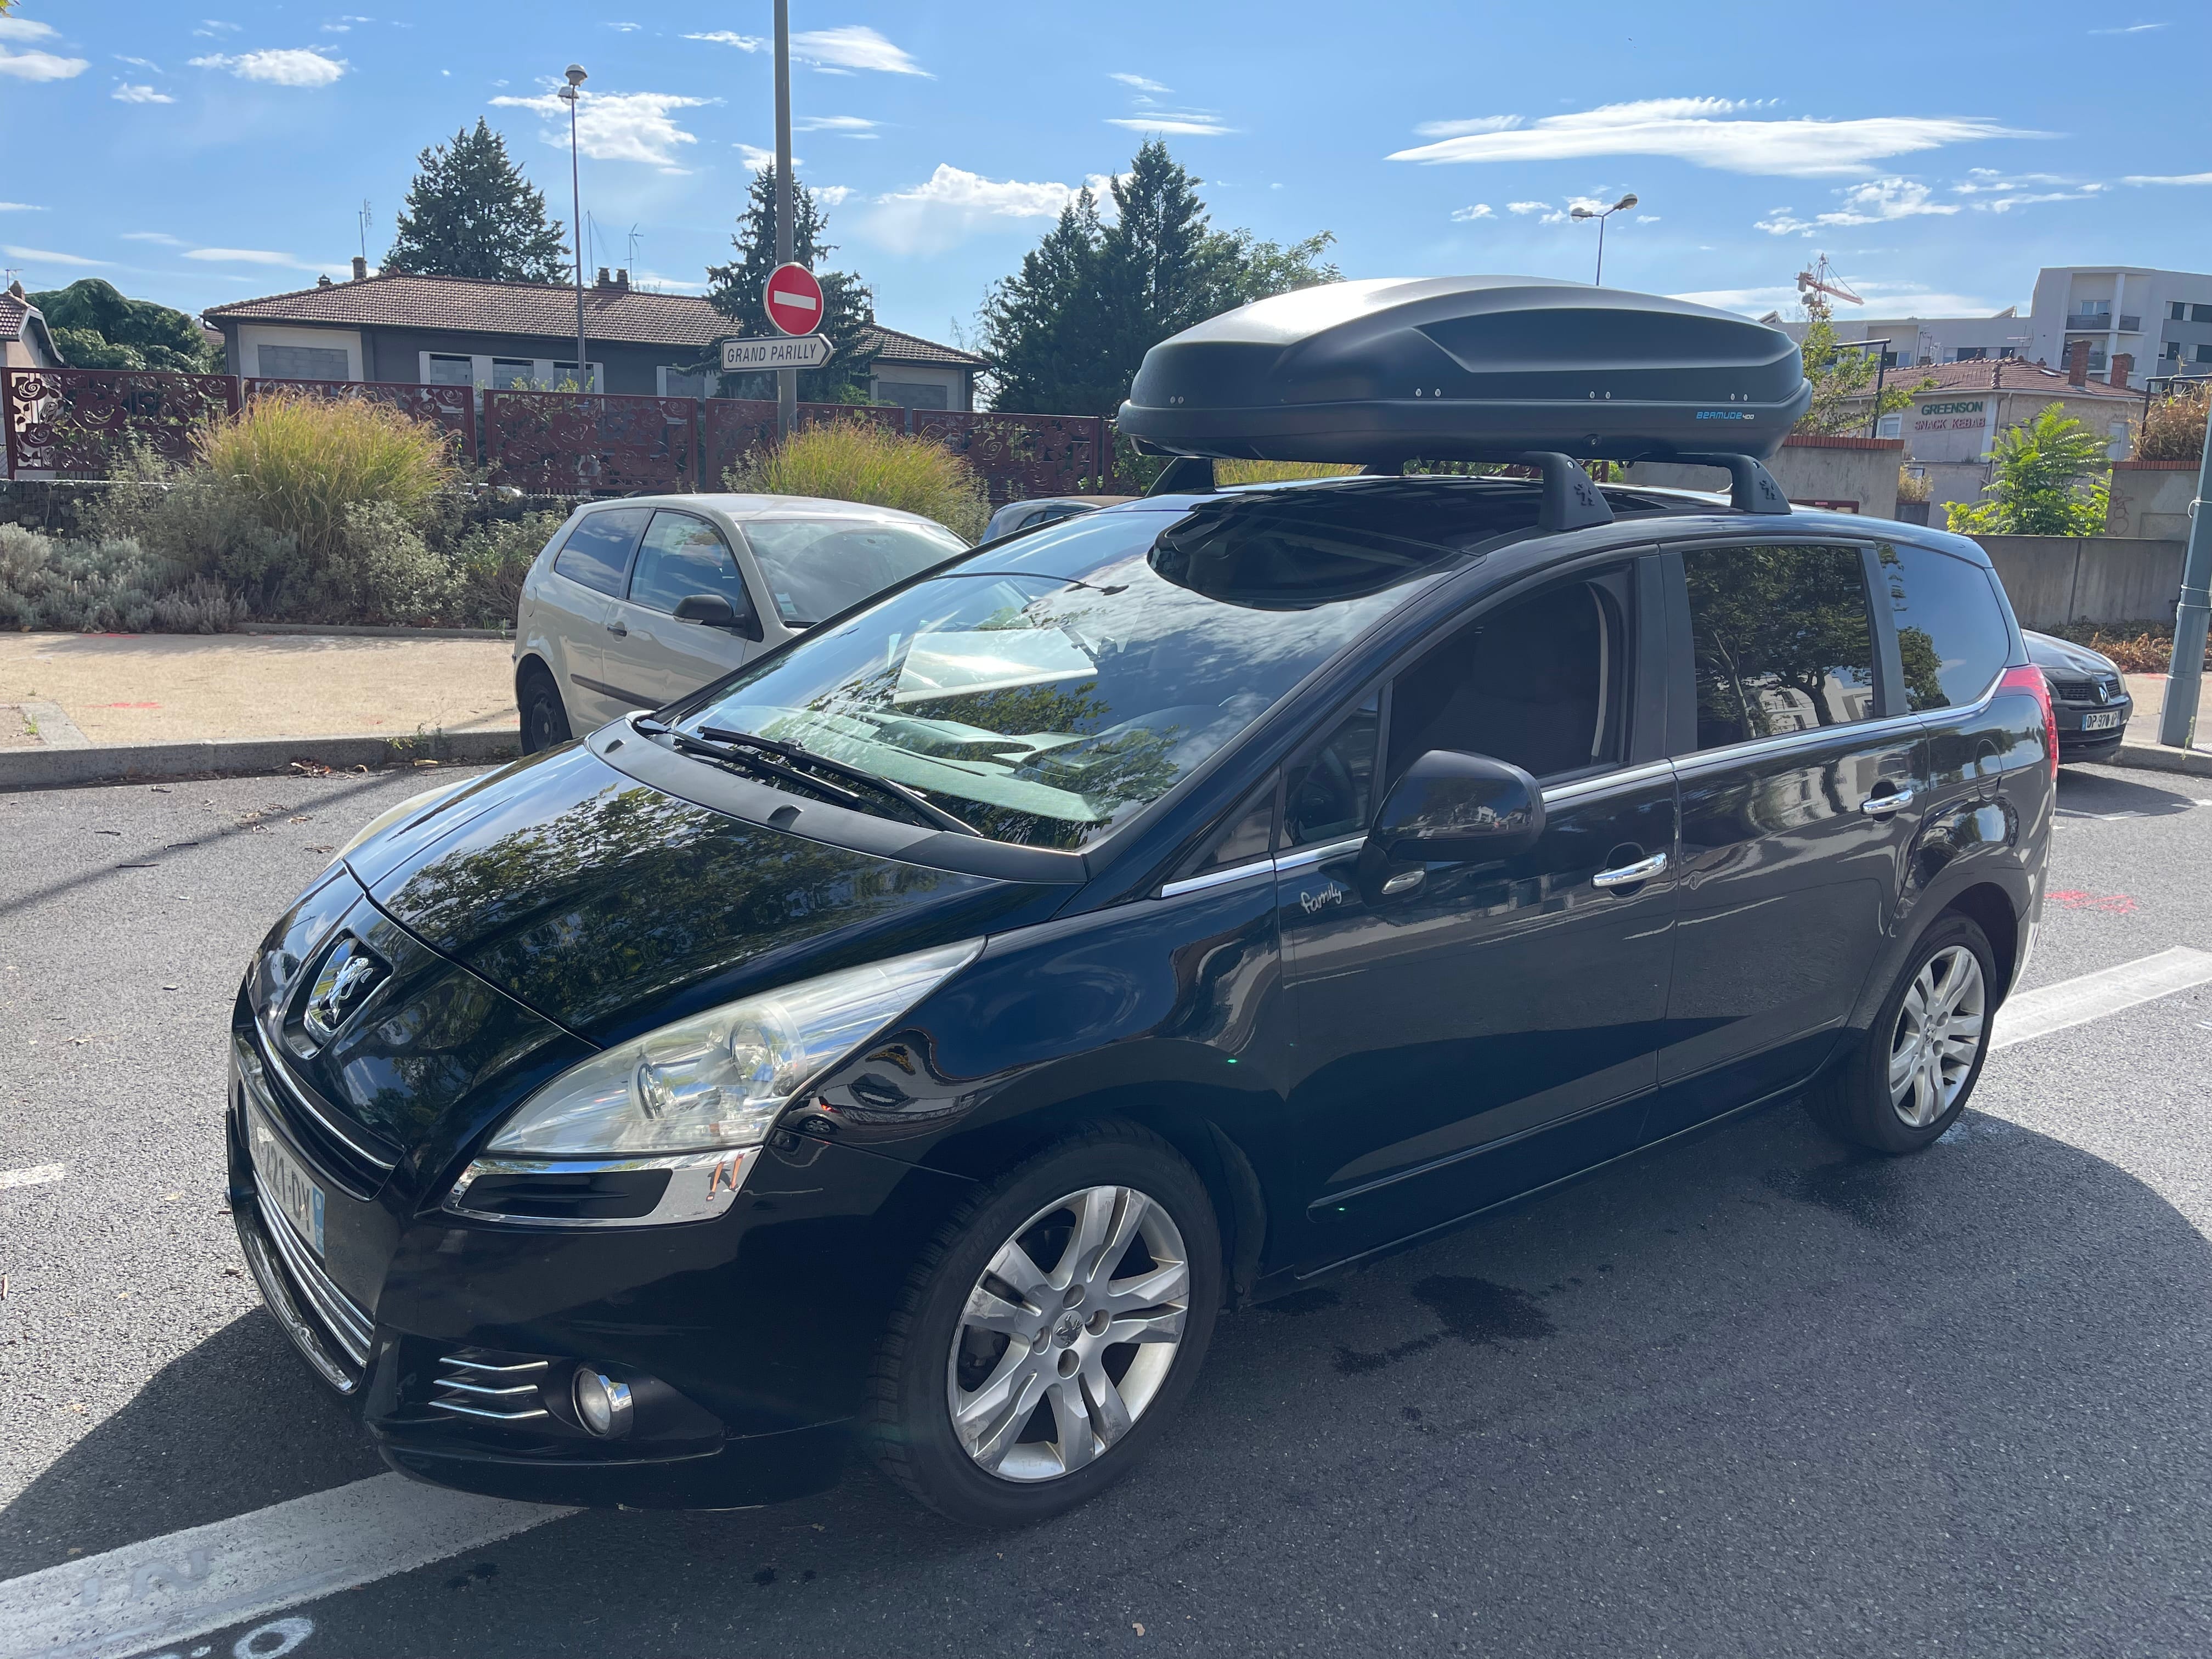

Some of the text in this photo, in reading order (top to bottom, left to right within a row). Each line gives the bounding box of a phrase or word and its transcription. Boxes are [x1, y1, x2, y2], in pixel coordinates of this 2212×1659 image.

[727, 343, 817, 363] GRAND PARILLY
[1921, 401, 1983, 415] GREENSON
[1915, 418, 1985, 430] SNACK KEBAB
[1300, 882, 1342, 914] family
